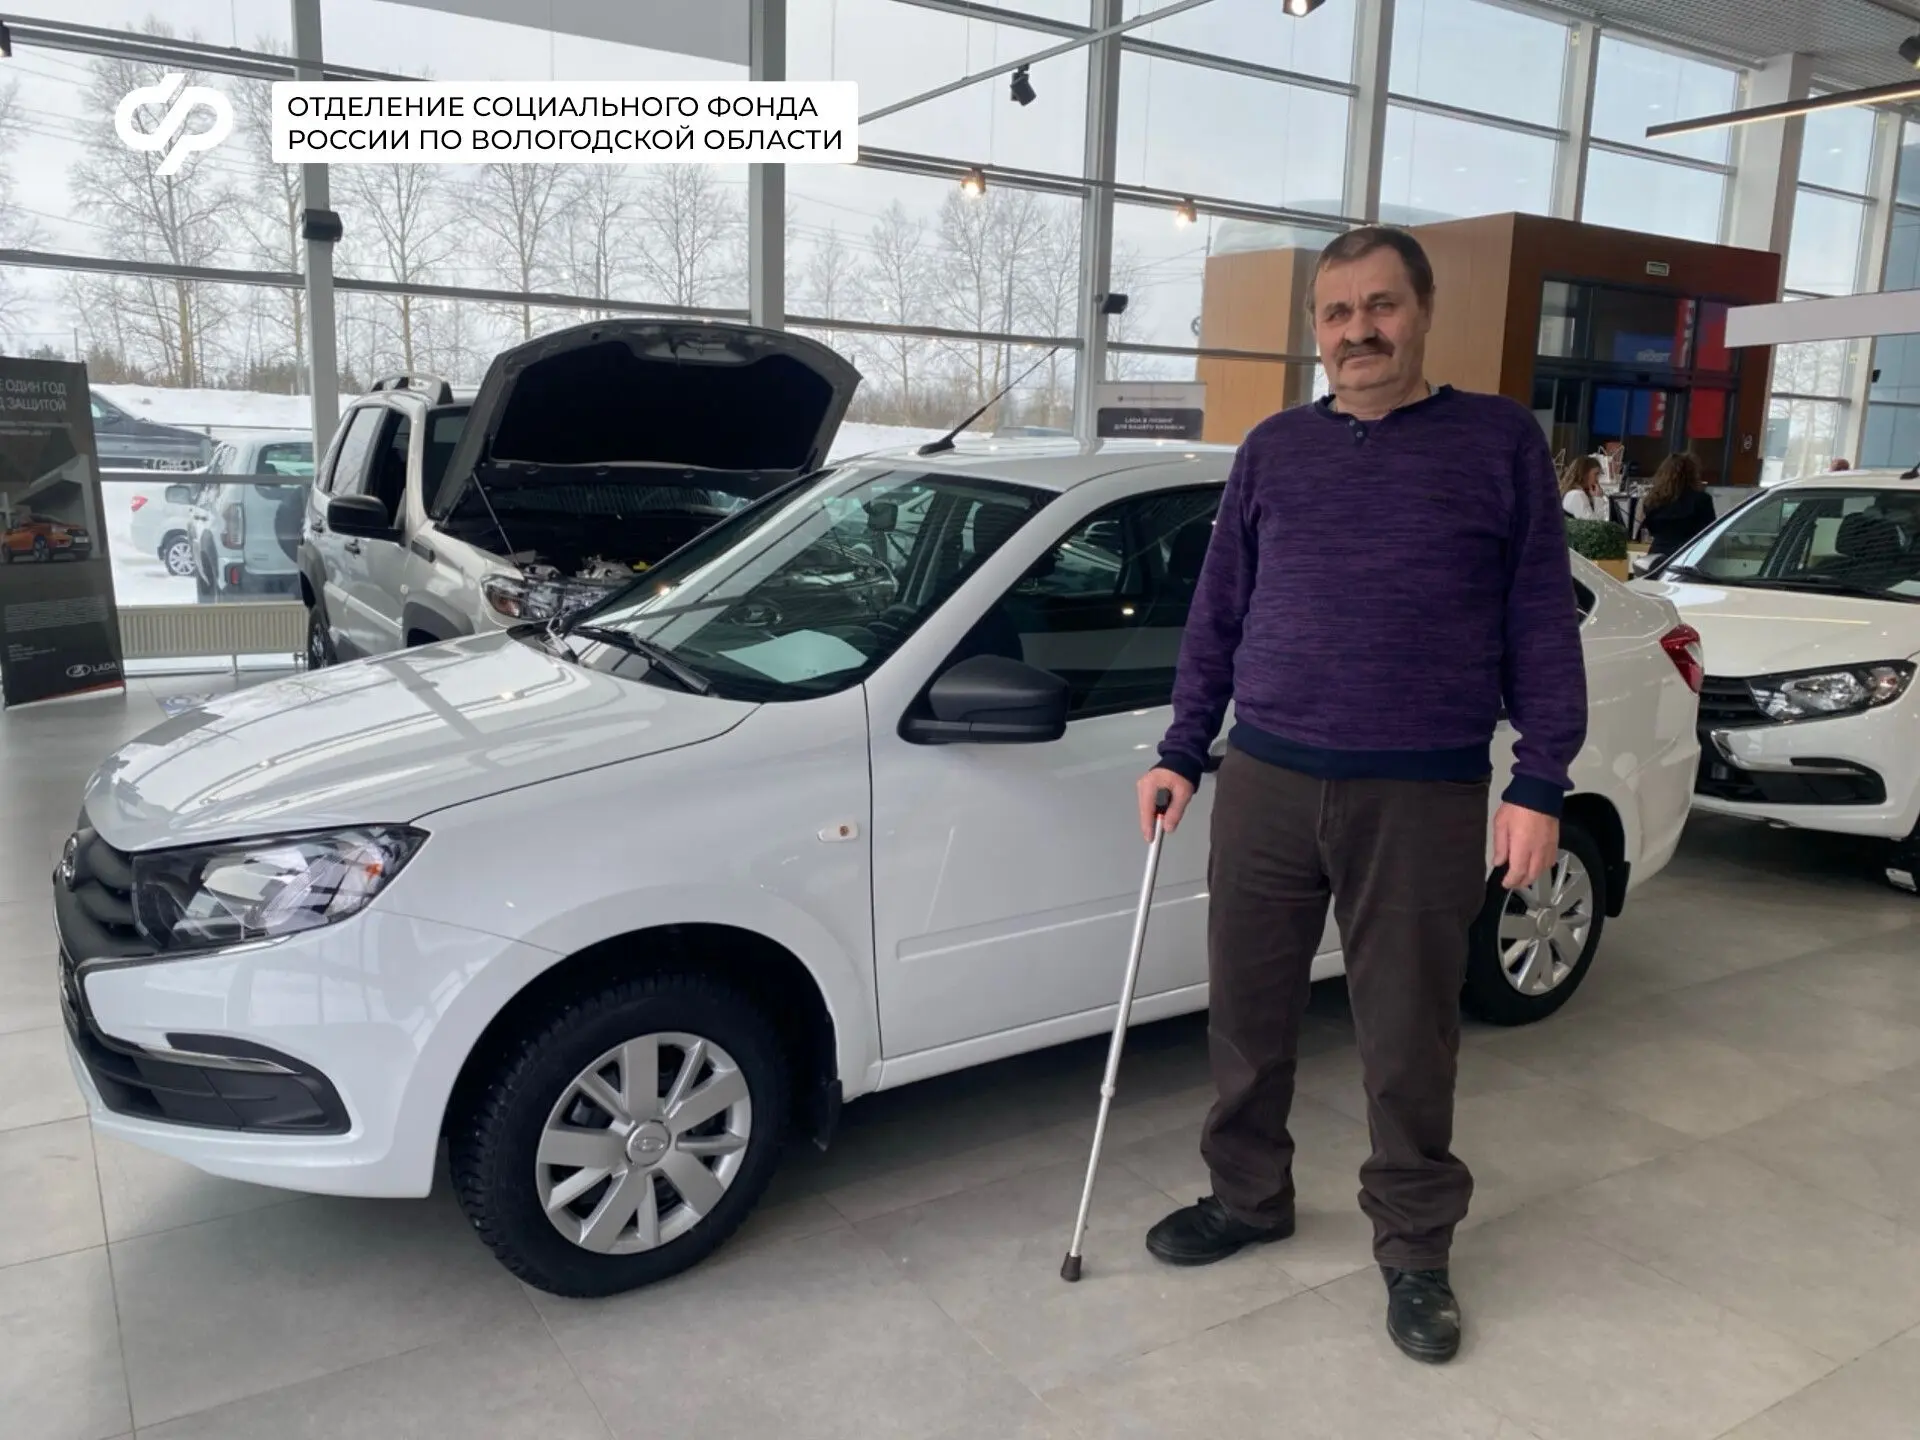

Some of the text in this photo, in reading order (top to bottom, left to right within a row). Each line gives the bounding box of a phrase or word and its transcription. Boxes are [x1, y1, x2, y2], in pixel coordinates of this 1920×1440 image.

[5, 380, 40, 394] ОДИН
[43, 381, 67, 397] ГОД
[7, 396, 67, 412] ЗАЩИТОЙ
